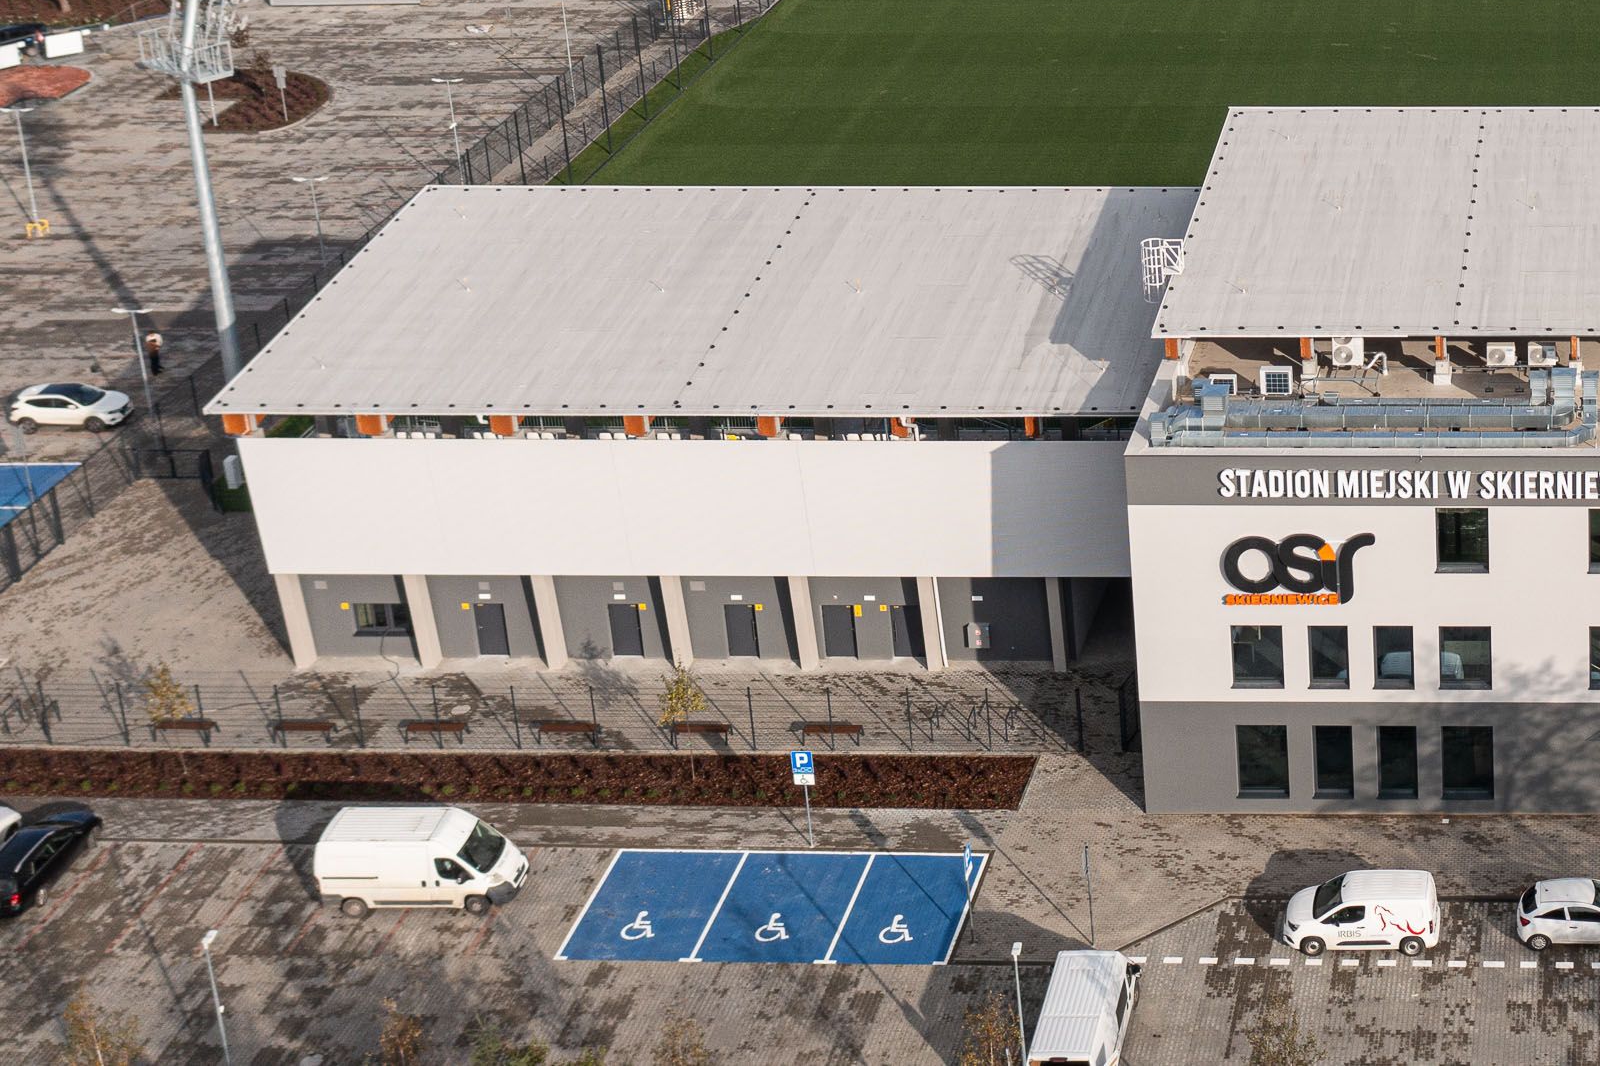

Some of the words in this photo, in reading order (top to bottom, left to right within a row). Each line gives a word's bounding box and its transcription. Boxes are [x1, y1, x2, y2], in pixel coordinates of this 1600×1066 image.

[1219, 468, 1329, 498] STADION
[1337, 469, 1439, 499] MIEJSKI
[1446, 470, 1472, 499] W
[1223, 593, 1340, 606] SKIERNIEWICE
[794, 752, 809, 768] P
[1337, 929, 1362, 938] IRBIS
